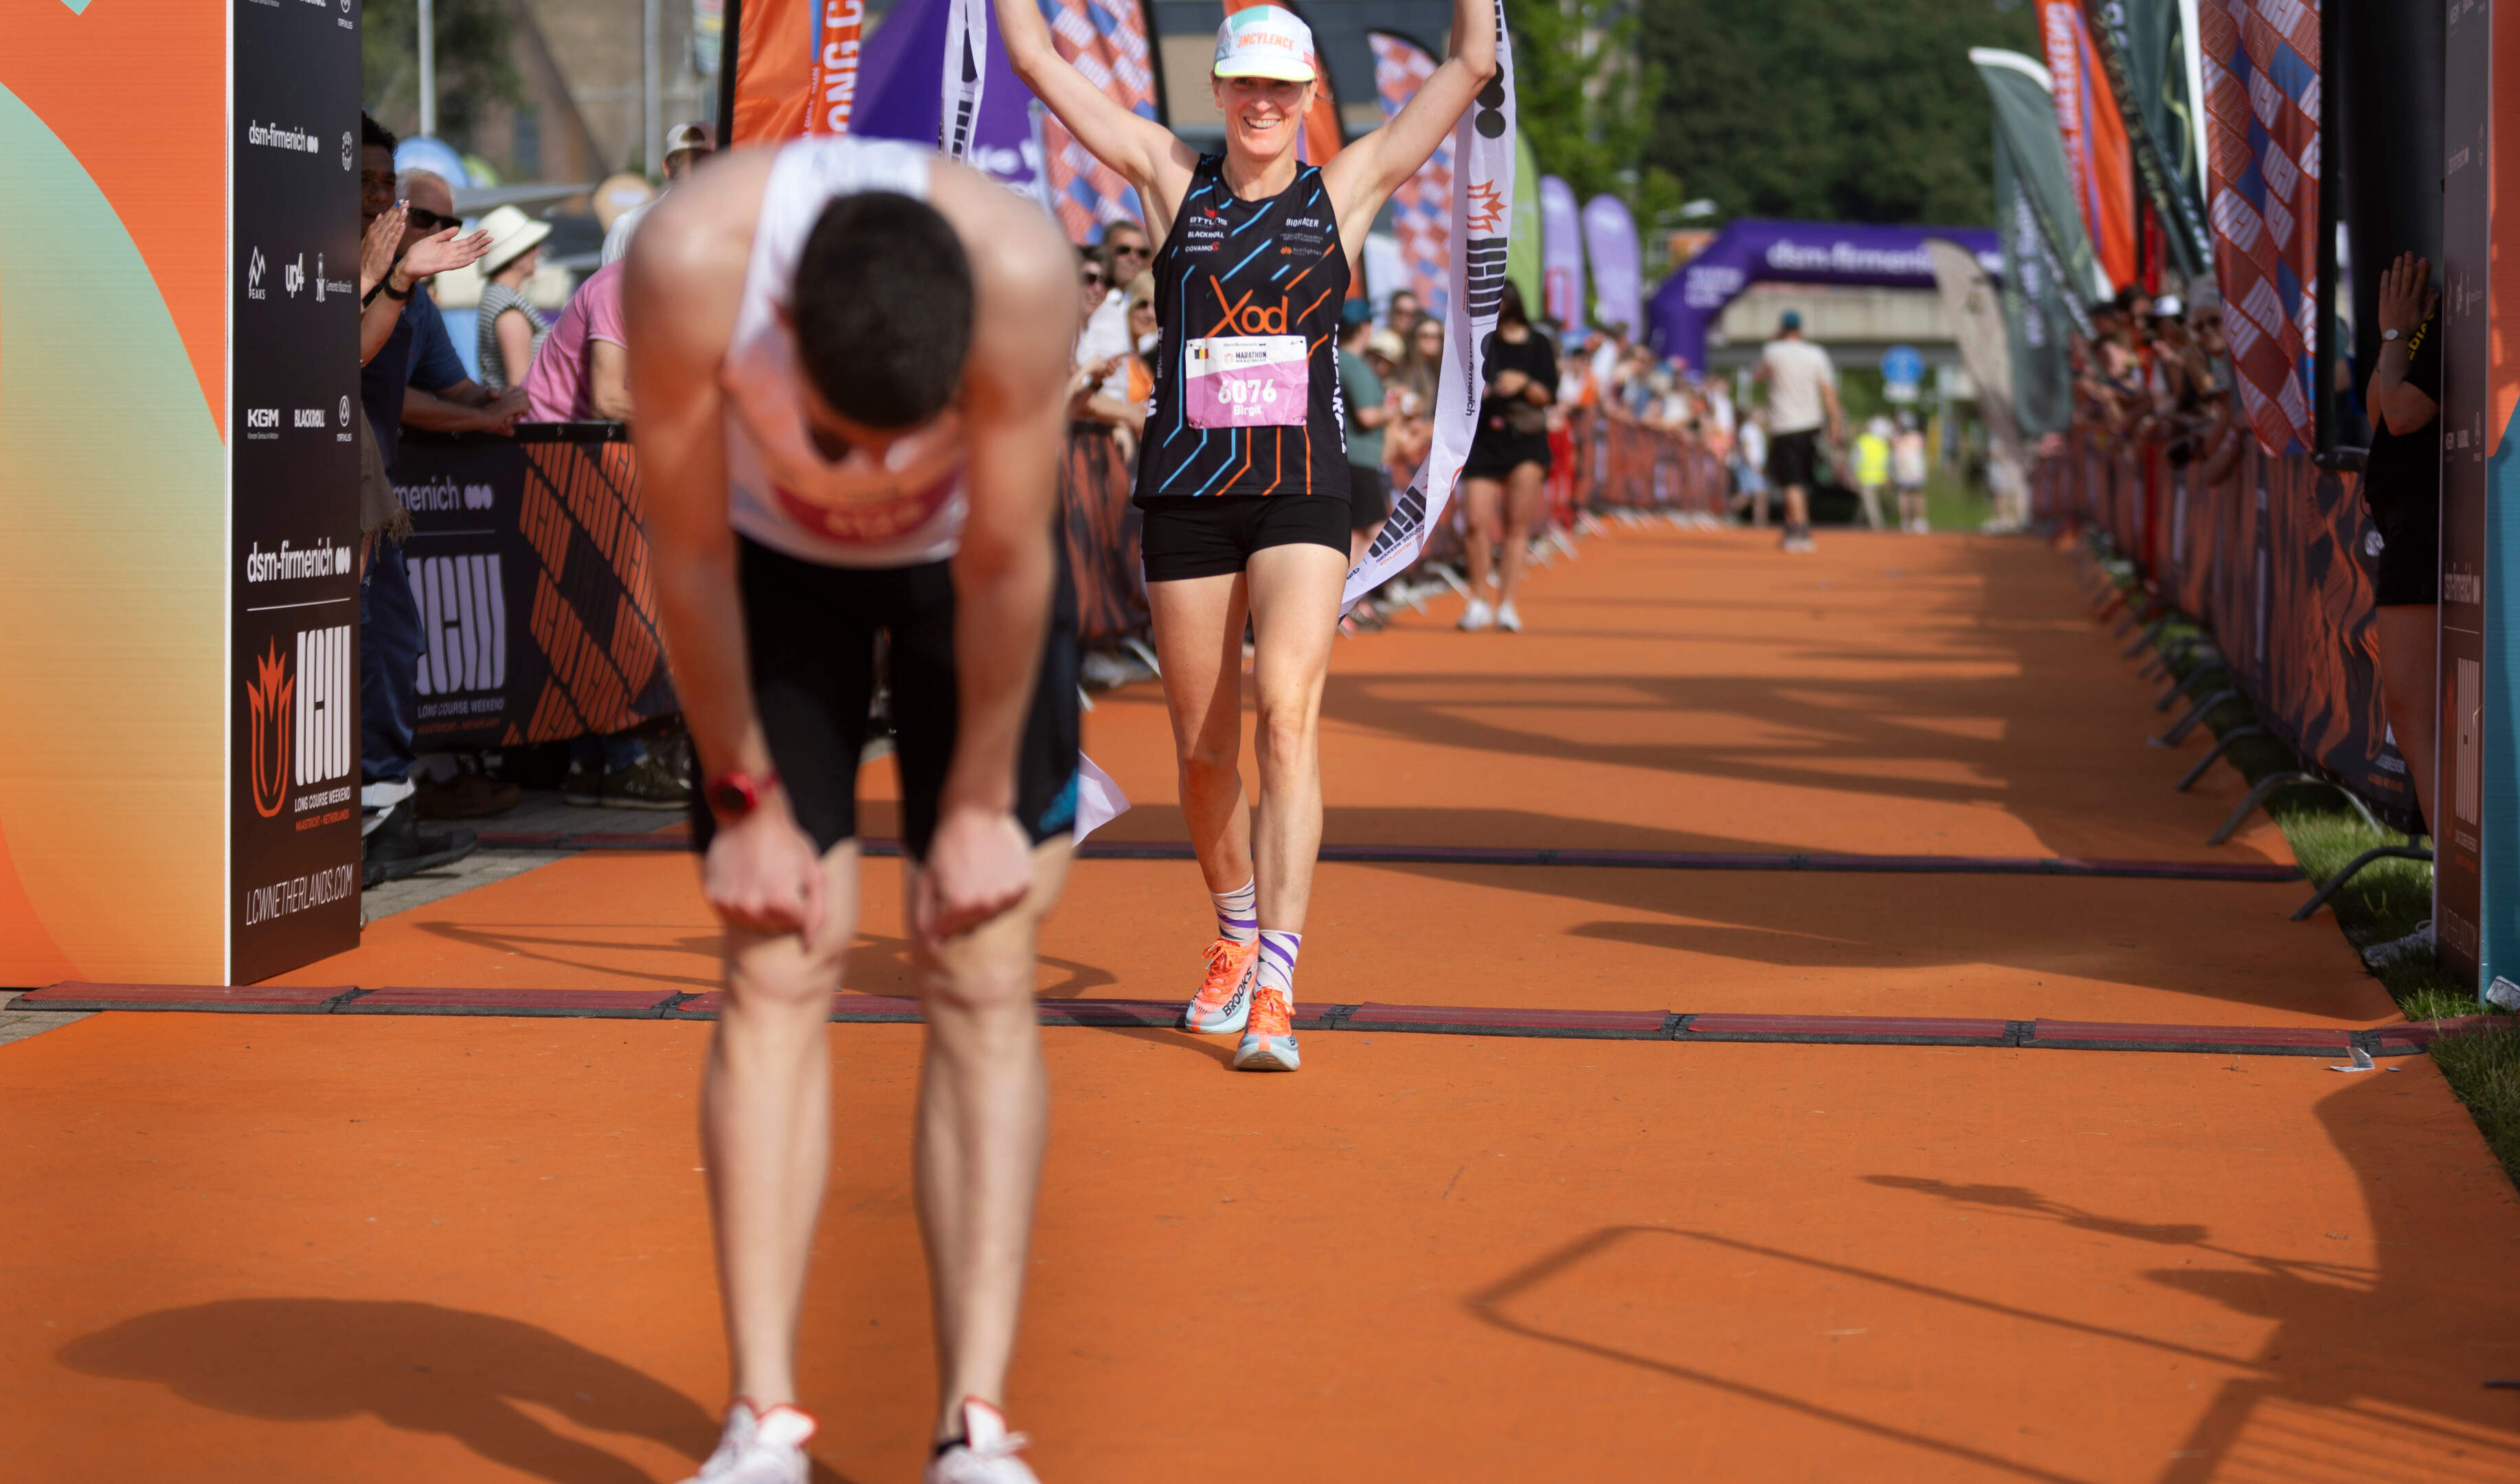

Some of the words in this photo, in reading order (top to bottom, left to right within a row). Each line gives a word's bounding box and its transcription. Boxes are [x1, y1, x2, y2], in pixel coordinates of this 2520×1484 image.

[1238, 32, 1294, 52] INCYLENCE
[249, 119, 306, 152] dsm-firmenich
[1187, 230, 1224, 238] BLACKROLL
[1285, 217, 1319, 227] BIORACER
[285, 253, 304, 298] up4
[248, 288, 266, 300] PEAKS
[1203, 275, 1288, 338] Xod
[1217, 379, 1277, 405] 6076
[247, 409, 279, 427] KGM
[294, 409, 326, 428] BLACKROLL
[1233, 405, 1262, 417] Birgit
[247, 537, 333, 583] dsm-firmenich
[418, 703, 438, 719] LONG
[438, 699, 469, 715] COURSE
[470, 697, 505, 714] WEEKEND
[295, 796, 308, 813] LONG
[308, 791, 328, 809] COURSE
[328, 785, 351, 805] WEEKEND
[245, 863, 354, 927] LCWNETHERLANDS.COM
[1222, 967, 1252, 1018] BROOKS
